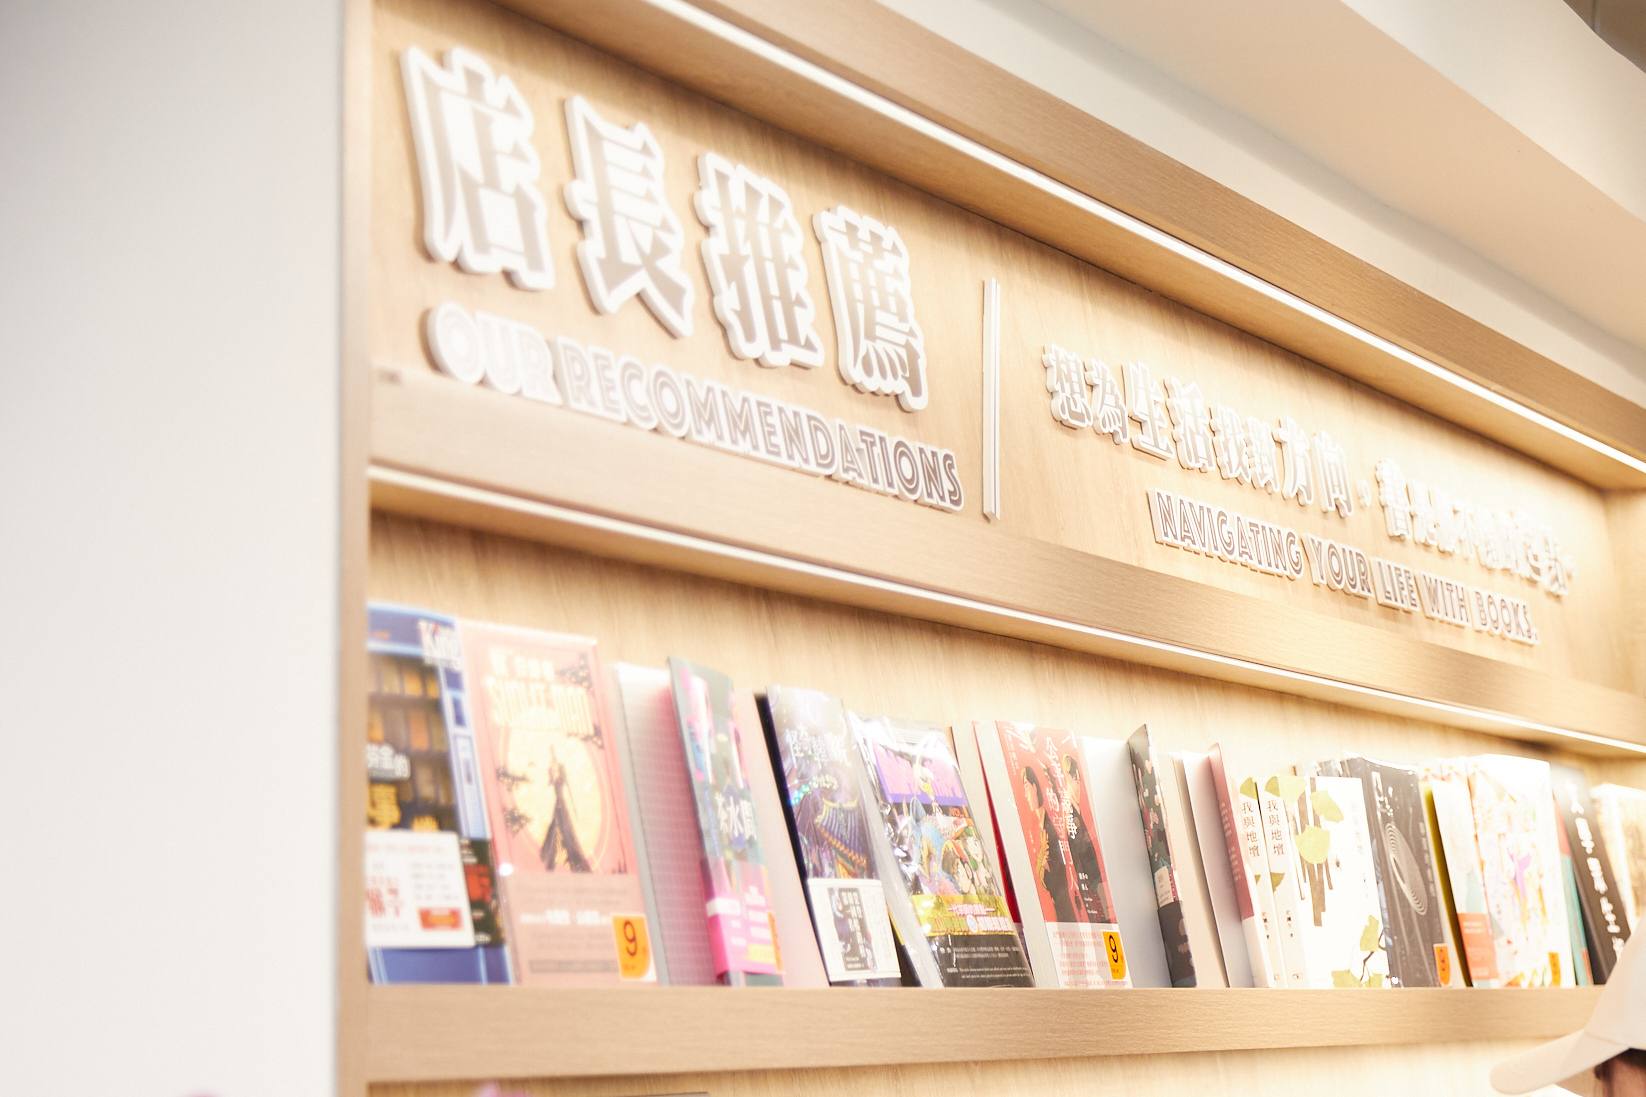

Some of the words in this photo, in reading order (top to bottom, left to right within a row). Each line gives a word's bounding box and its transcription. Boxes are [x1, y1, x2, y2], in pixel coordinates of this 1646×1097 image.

[401, 44, 928, 412] 店長推薦
[427, 302, 560, 407] OUR
[556, 335, 964, 513] RECOMMENDATIONS
[1147, 489, 1303, 579] NAVIGATING
[1303, 532, 1375, 599] YOUR
[1369, 557, 1421, 614] LIFE
[1419, 571, 1471, 629] WITH
[1471, 587, 1541, 645] BOOKS.
[713, 790, 758, 841] 茶水間
[1241, 800, 1261, 859] 我與地壇
[1266, 798, 1285, 857] 我與地壇
[621, 918, 640, 958] 9
[1107, 934, 1119, 964] 9
